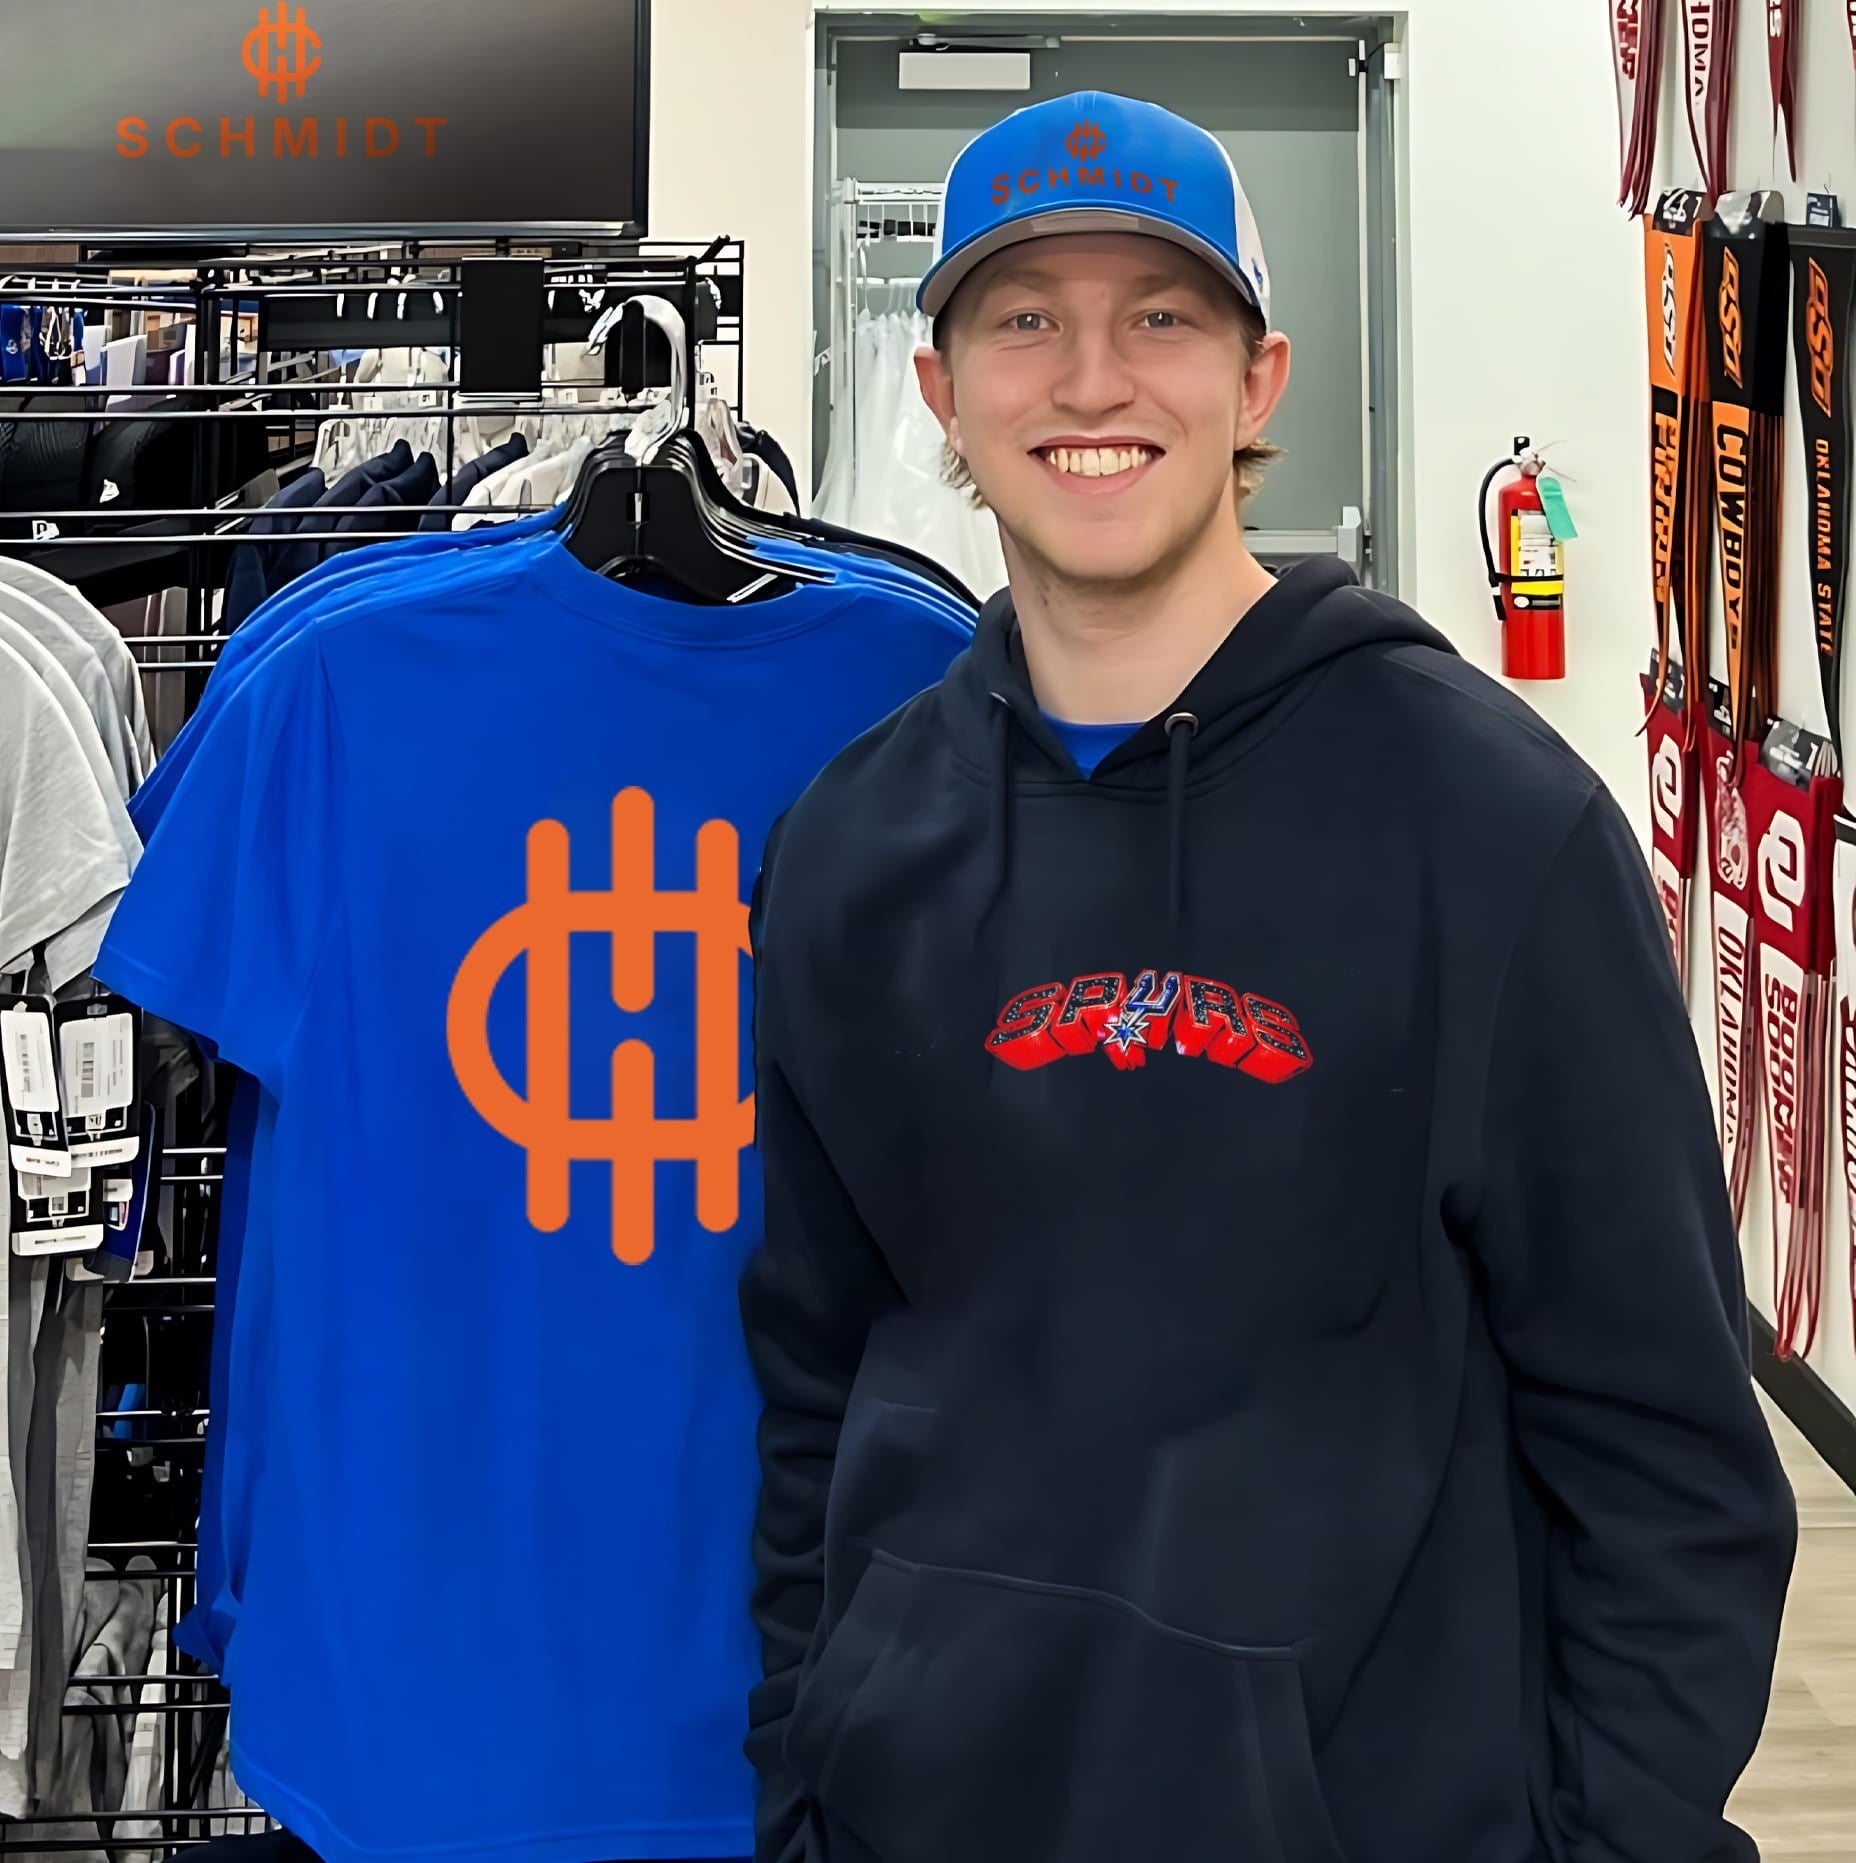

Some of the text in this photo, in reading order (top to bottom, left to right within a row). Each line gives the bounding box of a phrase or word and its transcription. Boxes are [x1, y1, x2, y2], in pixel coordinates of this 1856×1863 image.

[115, 116, 448, 159] SCHMIDT
[991, 166, 1179, 205] SCHMIDT
[1815, 438, 1832, 571] OKLAHOMA
[985, 969, 1314, 1084] SPURS
